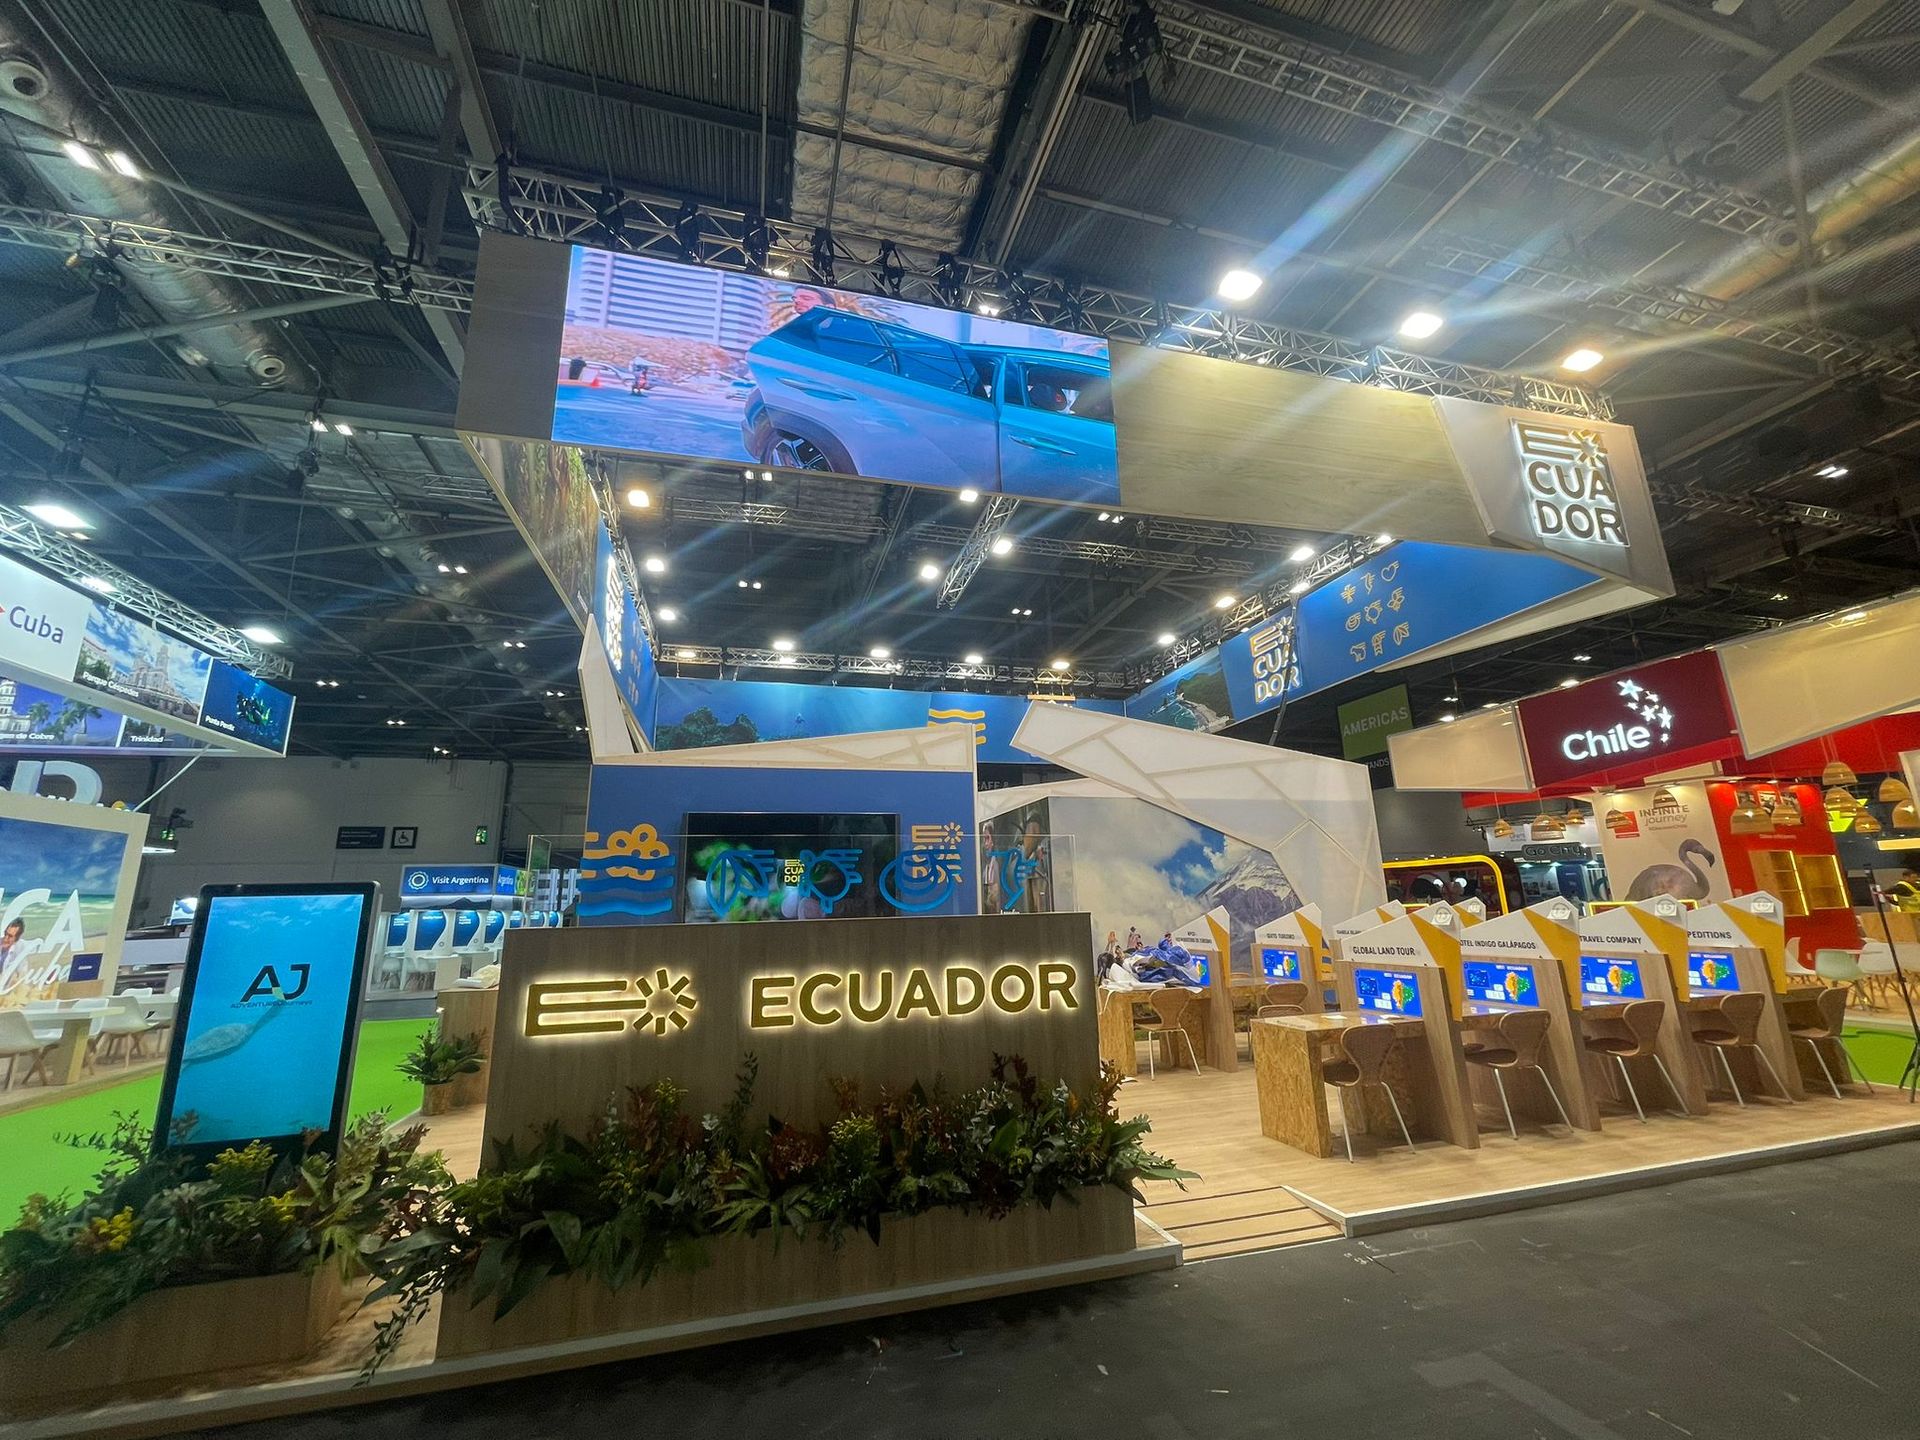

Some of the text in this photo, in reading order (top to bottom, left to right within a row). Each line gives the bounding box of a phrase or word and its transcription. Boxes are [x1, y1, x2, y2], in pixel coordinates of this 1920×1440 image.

[1528, 461, 1616, 504] CUA
[1535, 499, 1630, 546] DOR
[9, 605, 64, 644] Cuba
[82, 671, 108, 689] Parque
[1342, 706, 1409, 737] AMERICAS
[130, 735, 165, 743] Trinidad
[1562, 723, 1651, 761] Chile
[1639, 804, 1690, 818] INFINITE
[1645, 814, 1688, 827] journey
[1525, 846, 1547, 856] Go
[432, 875, 489, 886] Visit Argentina
[1475, 940, 1496, 948] INDIGO
[1579, 935, 1642, 944] TRAVEL COMPANY
[1353, 946, 1416, 956] GLOBAL LAND TOUR
[239, 963, 311, 1003] AJ
[751, 962, 1079, 1028] ECUADOR
